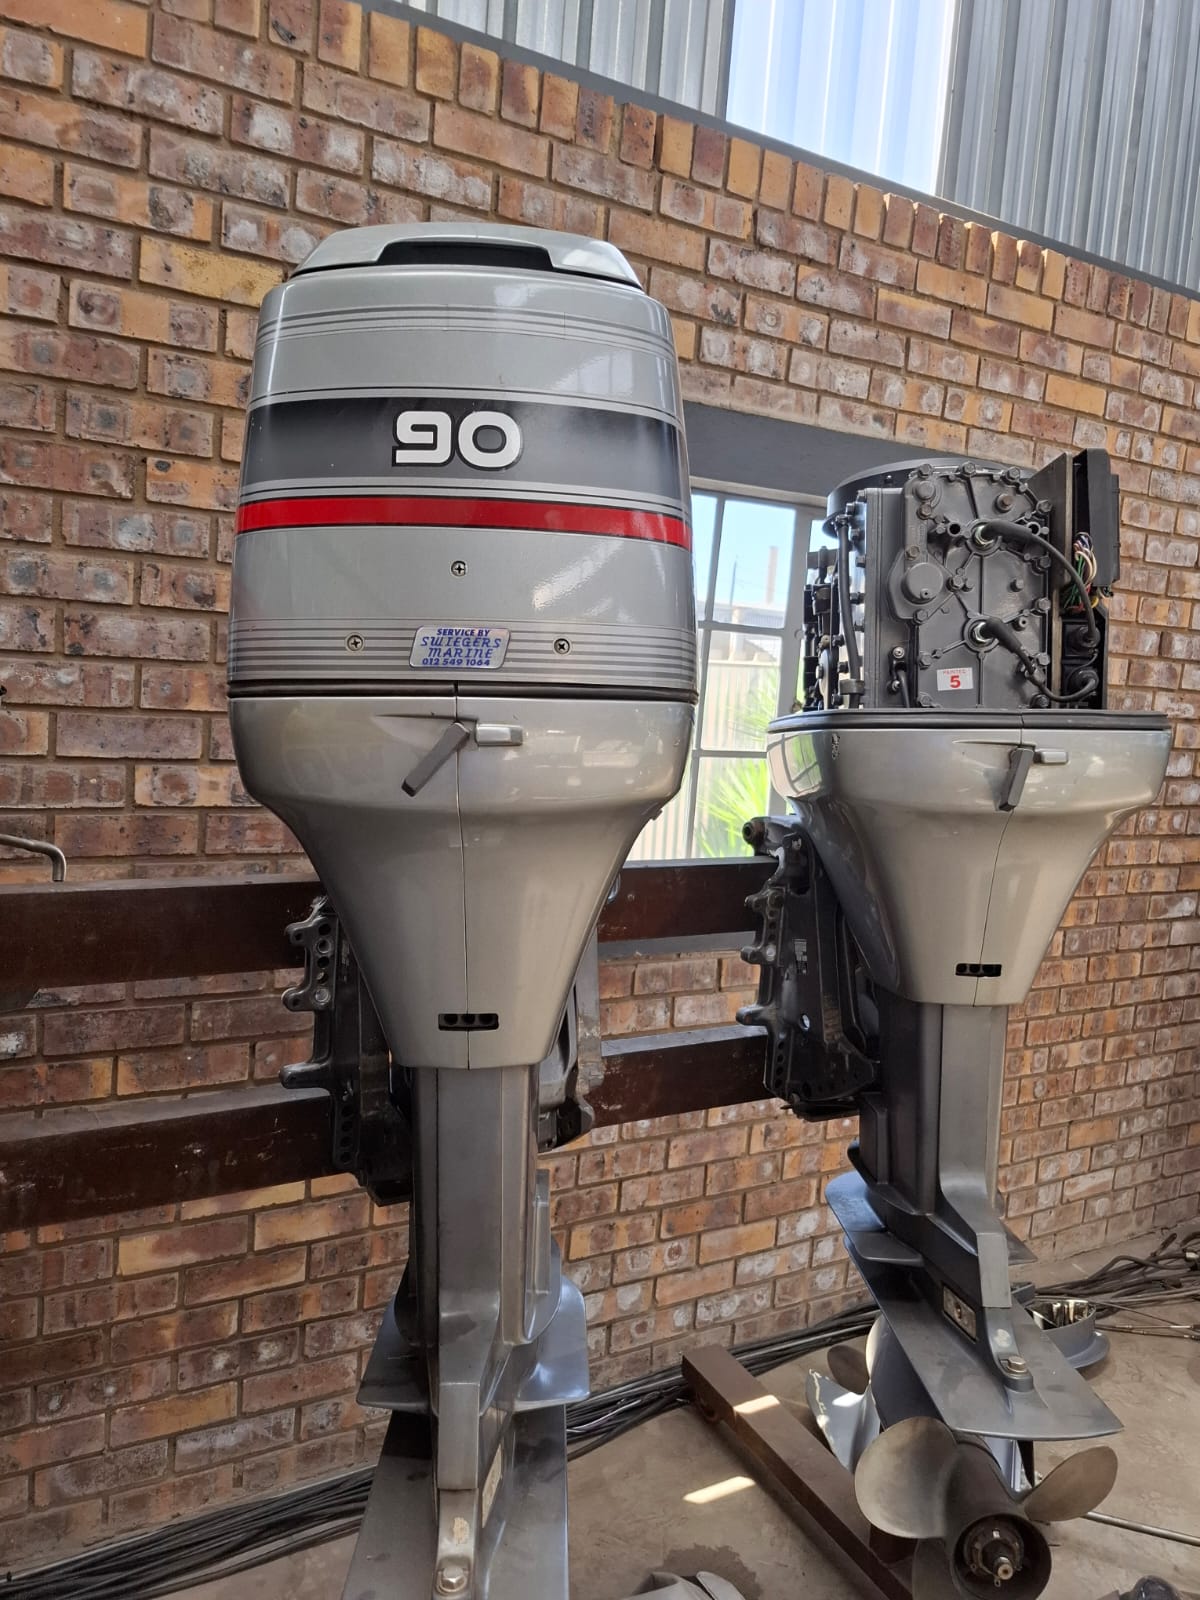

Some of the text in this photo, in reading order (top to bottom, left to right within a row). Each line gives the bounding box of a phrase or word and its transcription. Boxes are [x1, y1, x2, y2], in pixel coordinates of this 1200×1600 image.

[395, 410, 522, 469] 90
[437, 628, 490, 637] SERVICE BY
[442, 658, 463, 666] 549
[466, 658, 490, 666] 1064
[950, 675, 961, 688] 5
